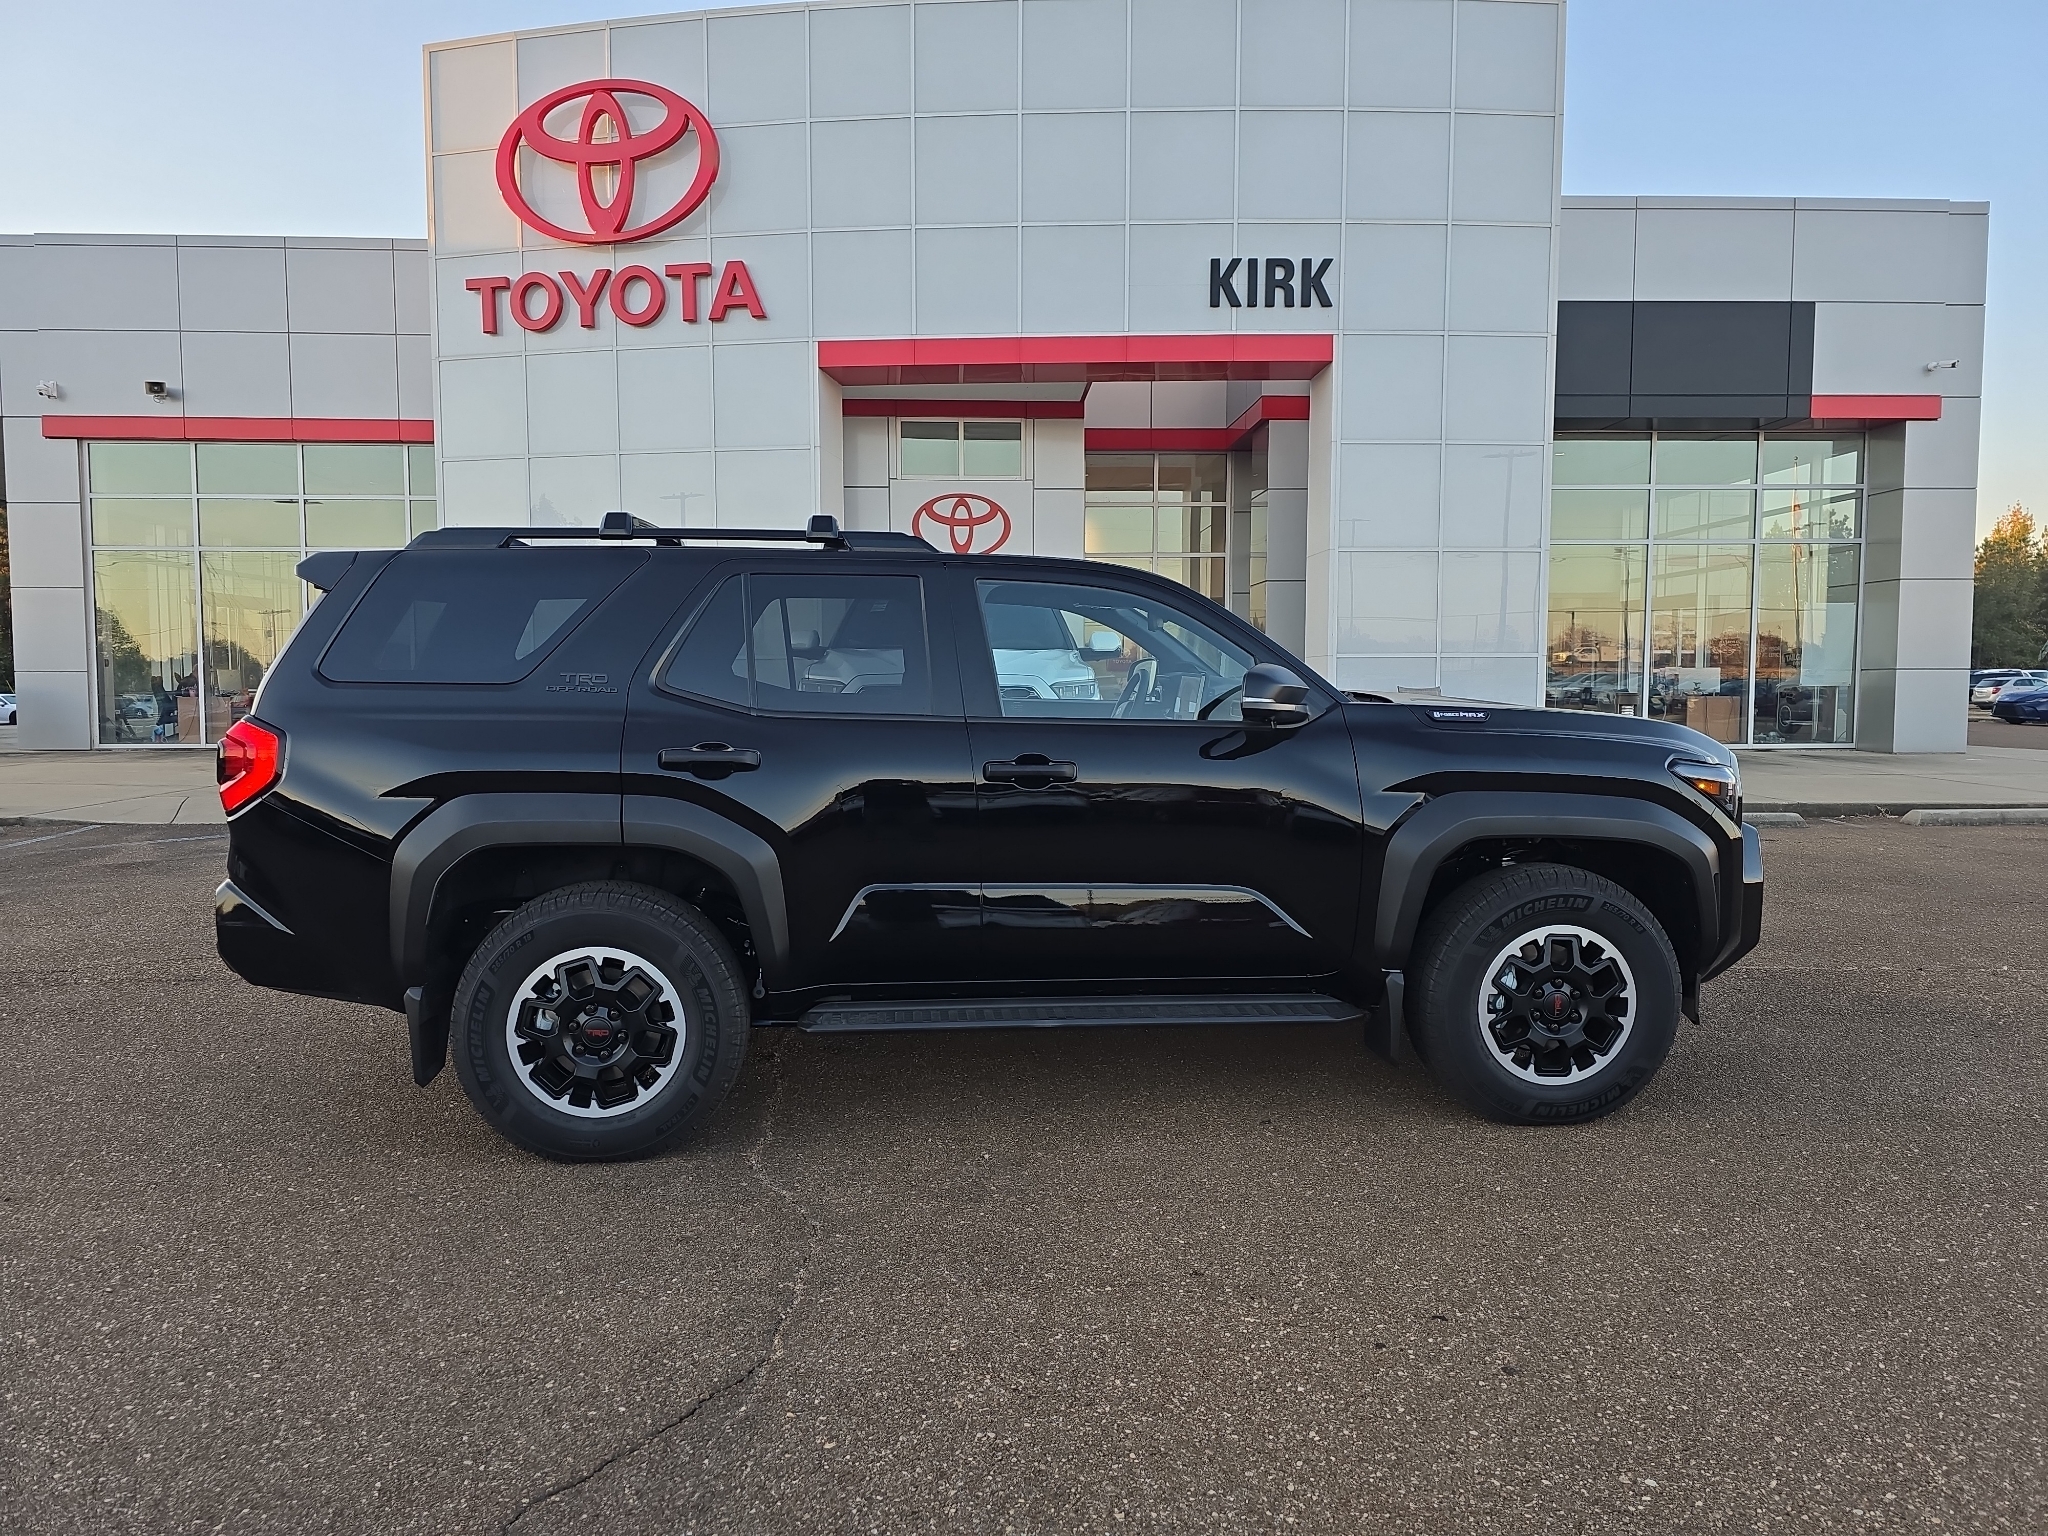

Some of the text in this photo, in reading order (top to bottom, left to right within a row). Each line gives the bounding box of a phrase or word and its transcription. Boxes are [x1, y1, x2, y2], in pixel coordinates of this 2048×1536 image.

[465, 260, 767, 335] TOYOTA
[1210, 257, 1334, 307] KIRK
[560, 672, 609, 686] TRD
[577, 686, 618, 694] ROAD
[1501, 897, 1588, 928] MICHELIN
[1603, 903, 1630, 921] 265/70
[491, 945, 515, 972] 265/70
[515, 939, 523, 948] R
[470, 986, 491, 1082] MICHELIN
[585, 1029, 610, 1037] TRD
[697, 988, 717, 1081] MICHELIN
[681, 1098, 696, 1114] LTX
[1534, 1085, 1621, 1117] MICHELIN
